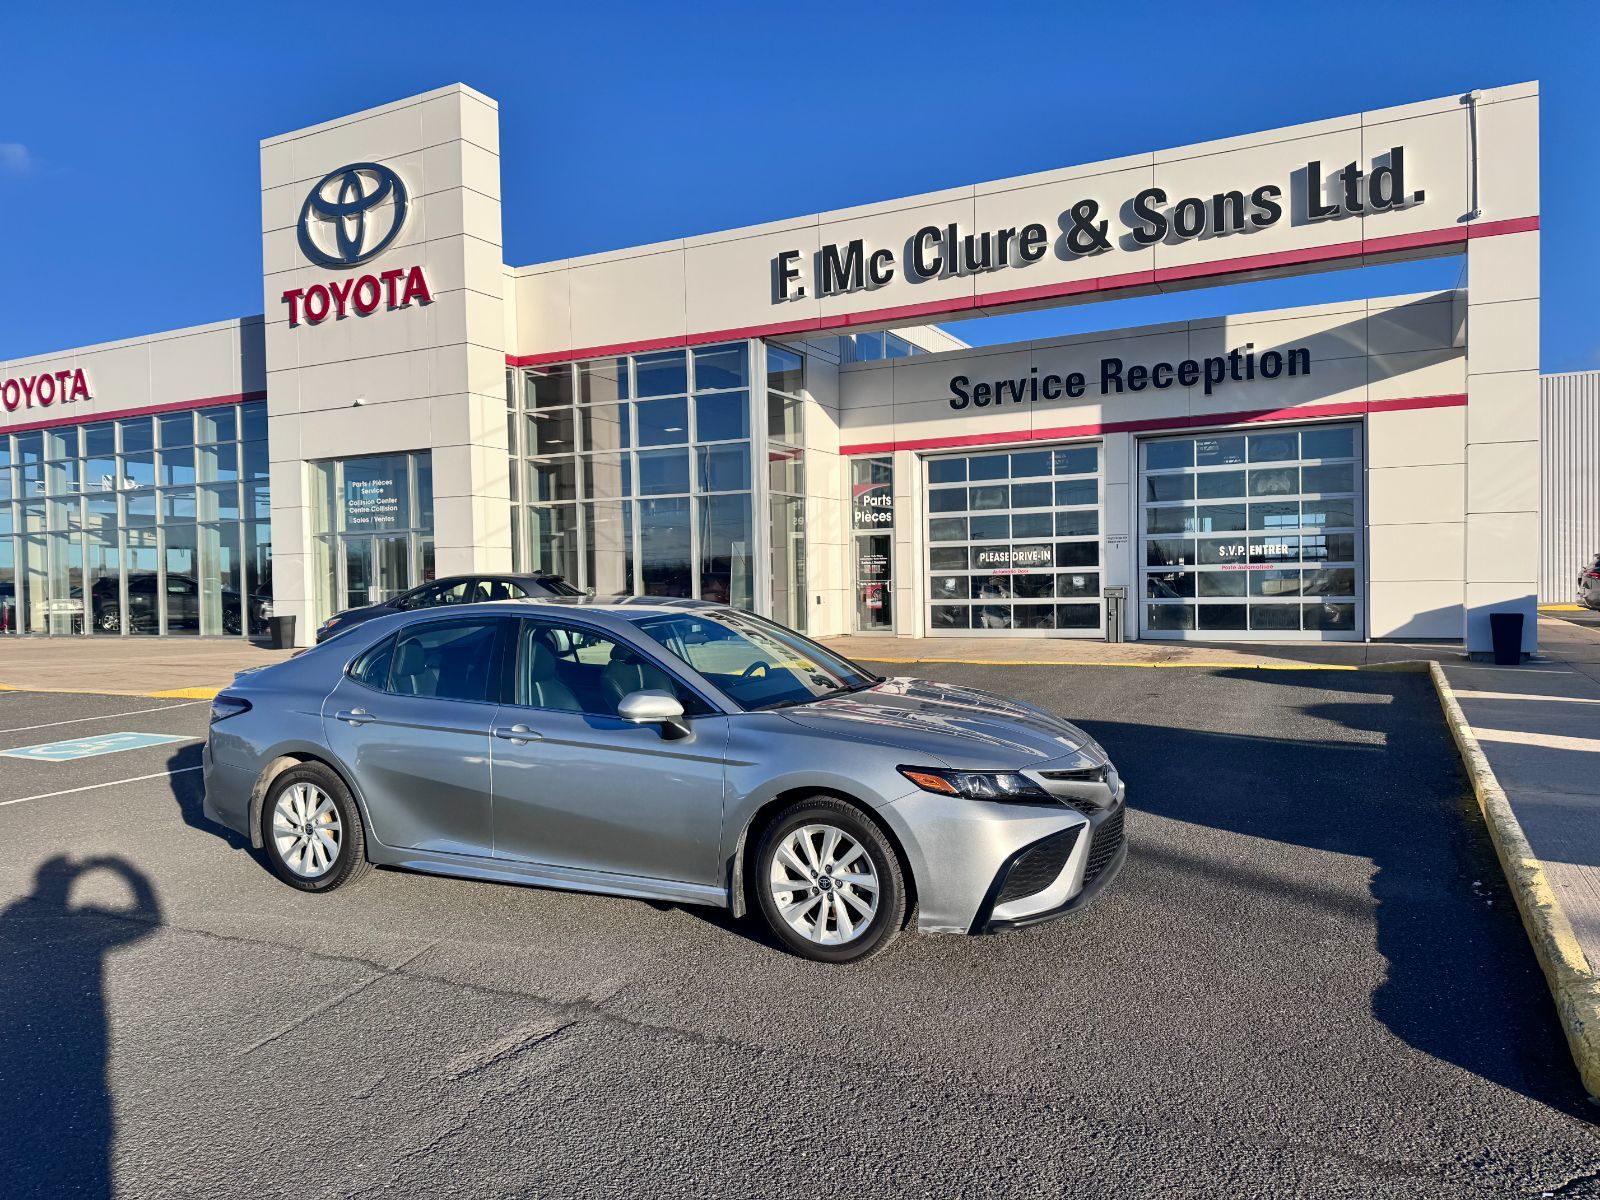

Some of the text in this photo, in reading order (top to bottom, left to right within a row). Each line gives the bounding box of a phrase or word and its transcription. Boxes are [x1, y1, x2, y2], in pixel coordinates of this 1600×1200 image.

[778, 146, 1425, 299] F. Mc Clure & Sons Ltd.
[282, 265, 431, 325] TOYOTA
[949, 342, 1312, 411] Service Reception
[0, 368, 90, 411] OYOTA
[361, 487, 384, 495] Service
[348, 497, 398, 507] Collision Center
[863, 494, 892, 507] Parts
[854, 510, 892, 523] Pièces
[979, 550, 1051, 562] PLEASE DRIVE-IN
[1219, 544, 1289, 557] S.V.P. ENTRER
